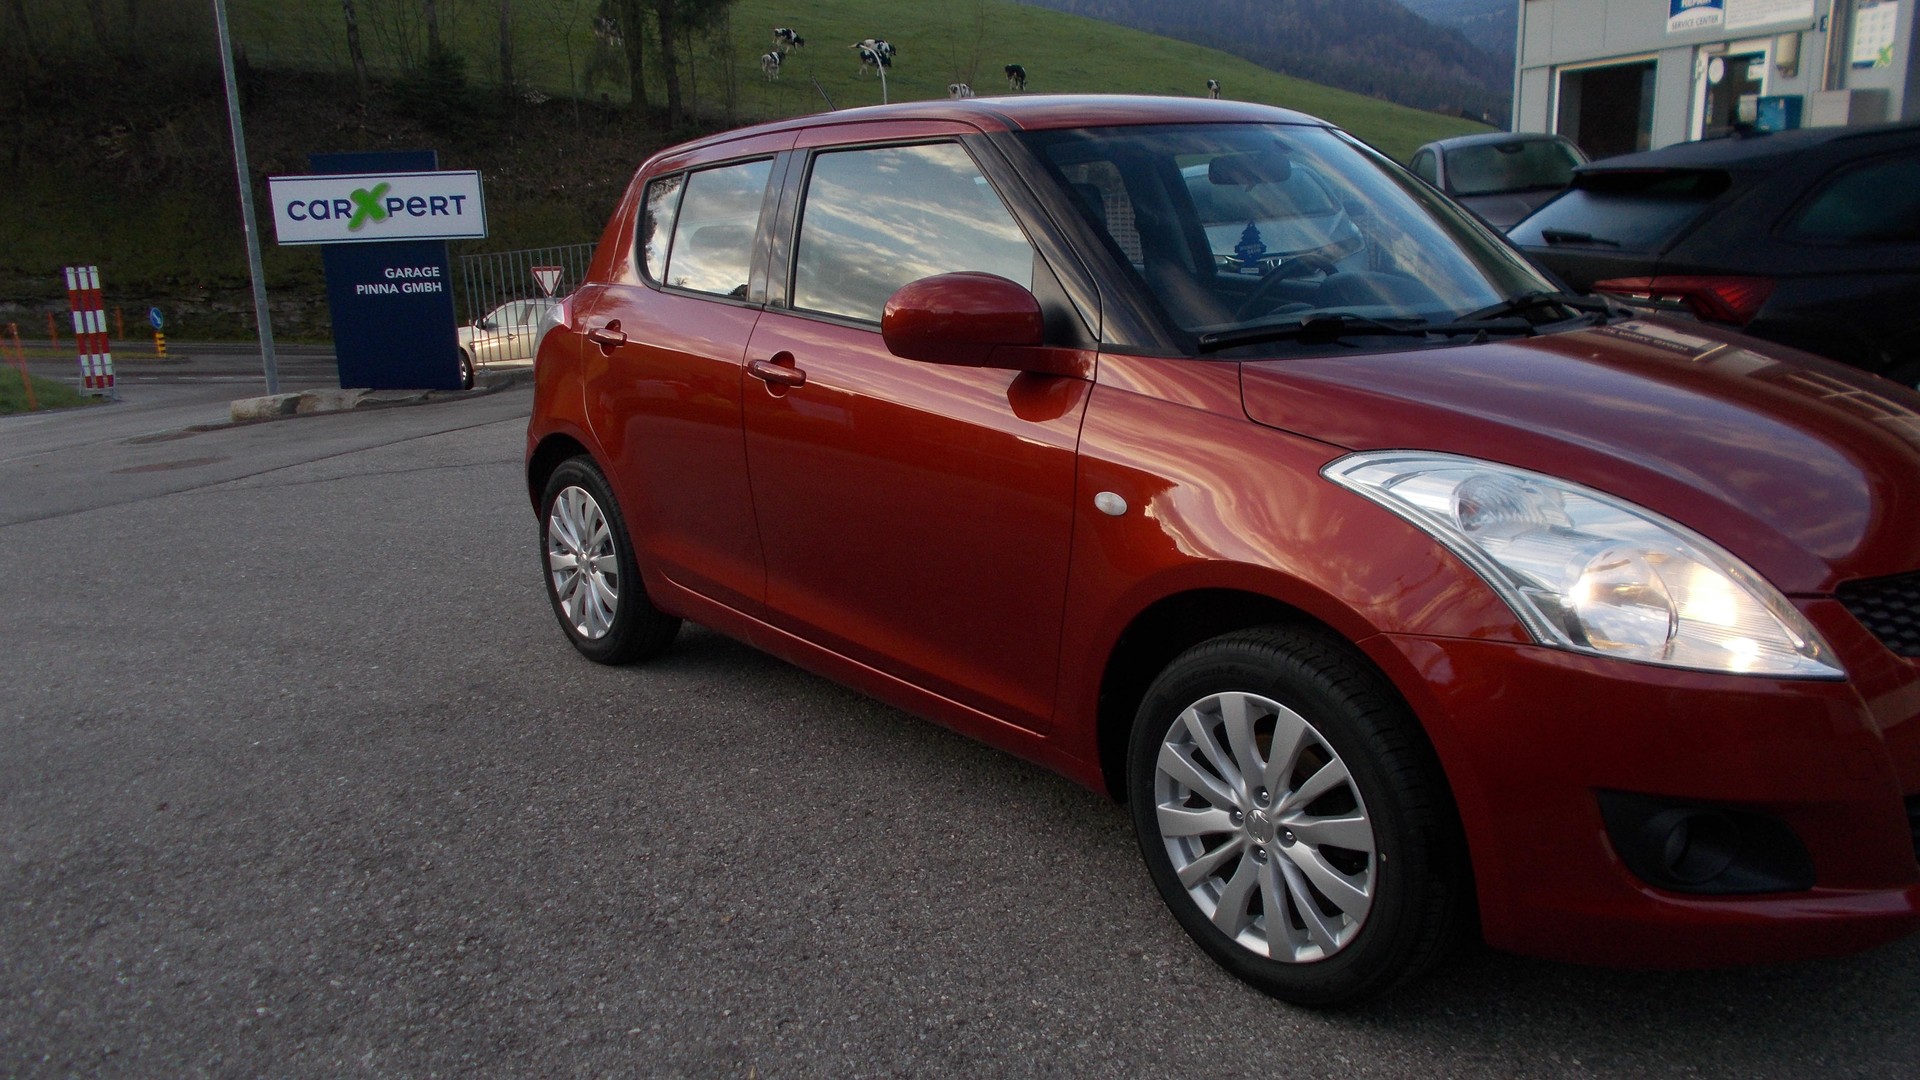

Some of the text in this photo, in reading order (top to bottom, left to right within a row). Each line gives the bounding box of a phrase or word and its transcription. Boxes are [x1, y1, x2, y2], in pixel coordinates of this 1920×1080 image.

[1671, 14, 1719, 30] SERVICE CENTER
[384, 266, 441, 278] GARAGE
[356, 281, 442, 295] PINNA GMBH
